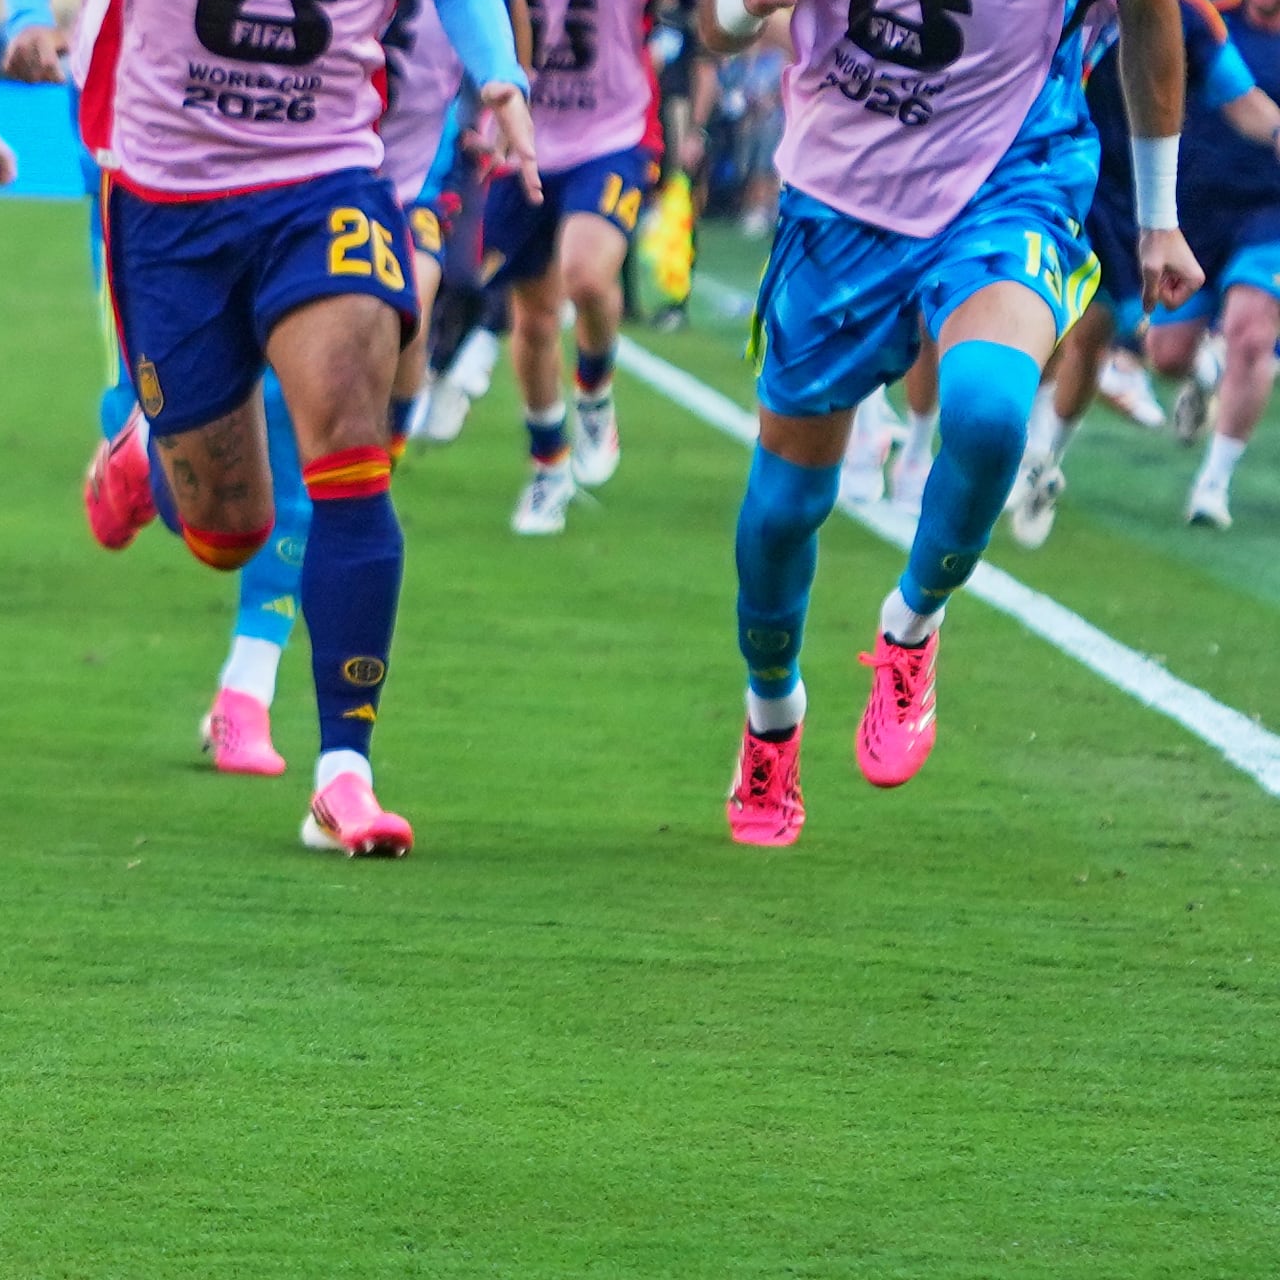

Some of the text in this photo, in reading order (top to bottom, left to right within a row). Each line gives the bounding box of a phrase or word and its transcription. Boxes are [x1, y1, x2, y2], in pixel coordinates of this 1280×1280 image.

[230, 19, 297, 51] FIFA
[870, 15, 922, 56] FIFA
[181, 85, 317, 122] 2026
[819, 71, 934, 126] 2026
[327, 206, 406, 292] 26
